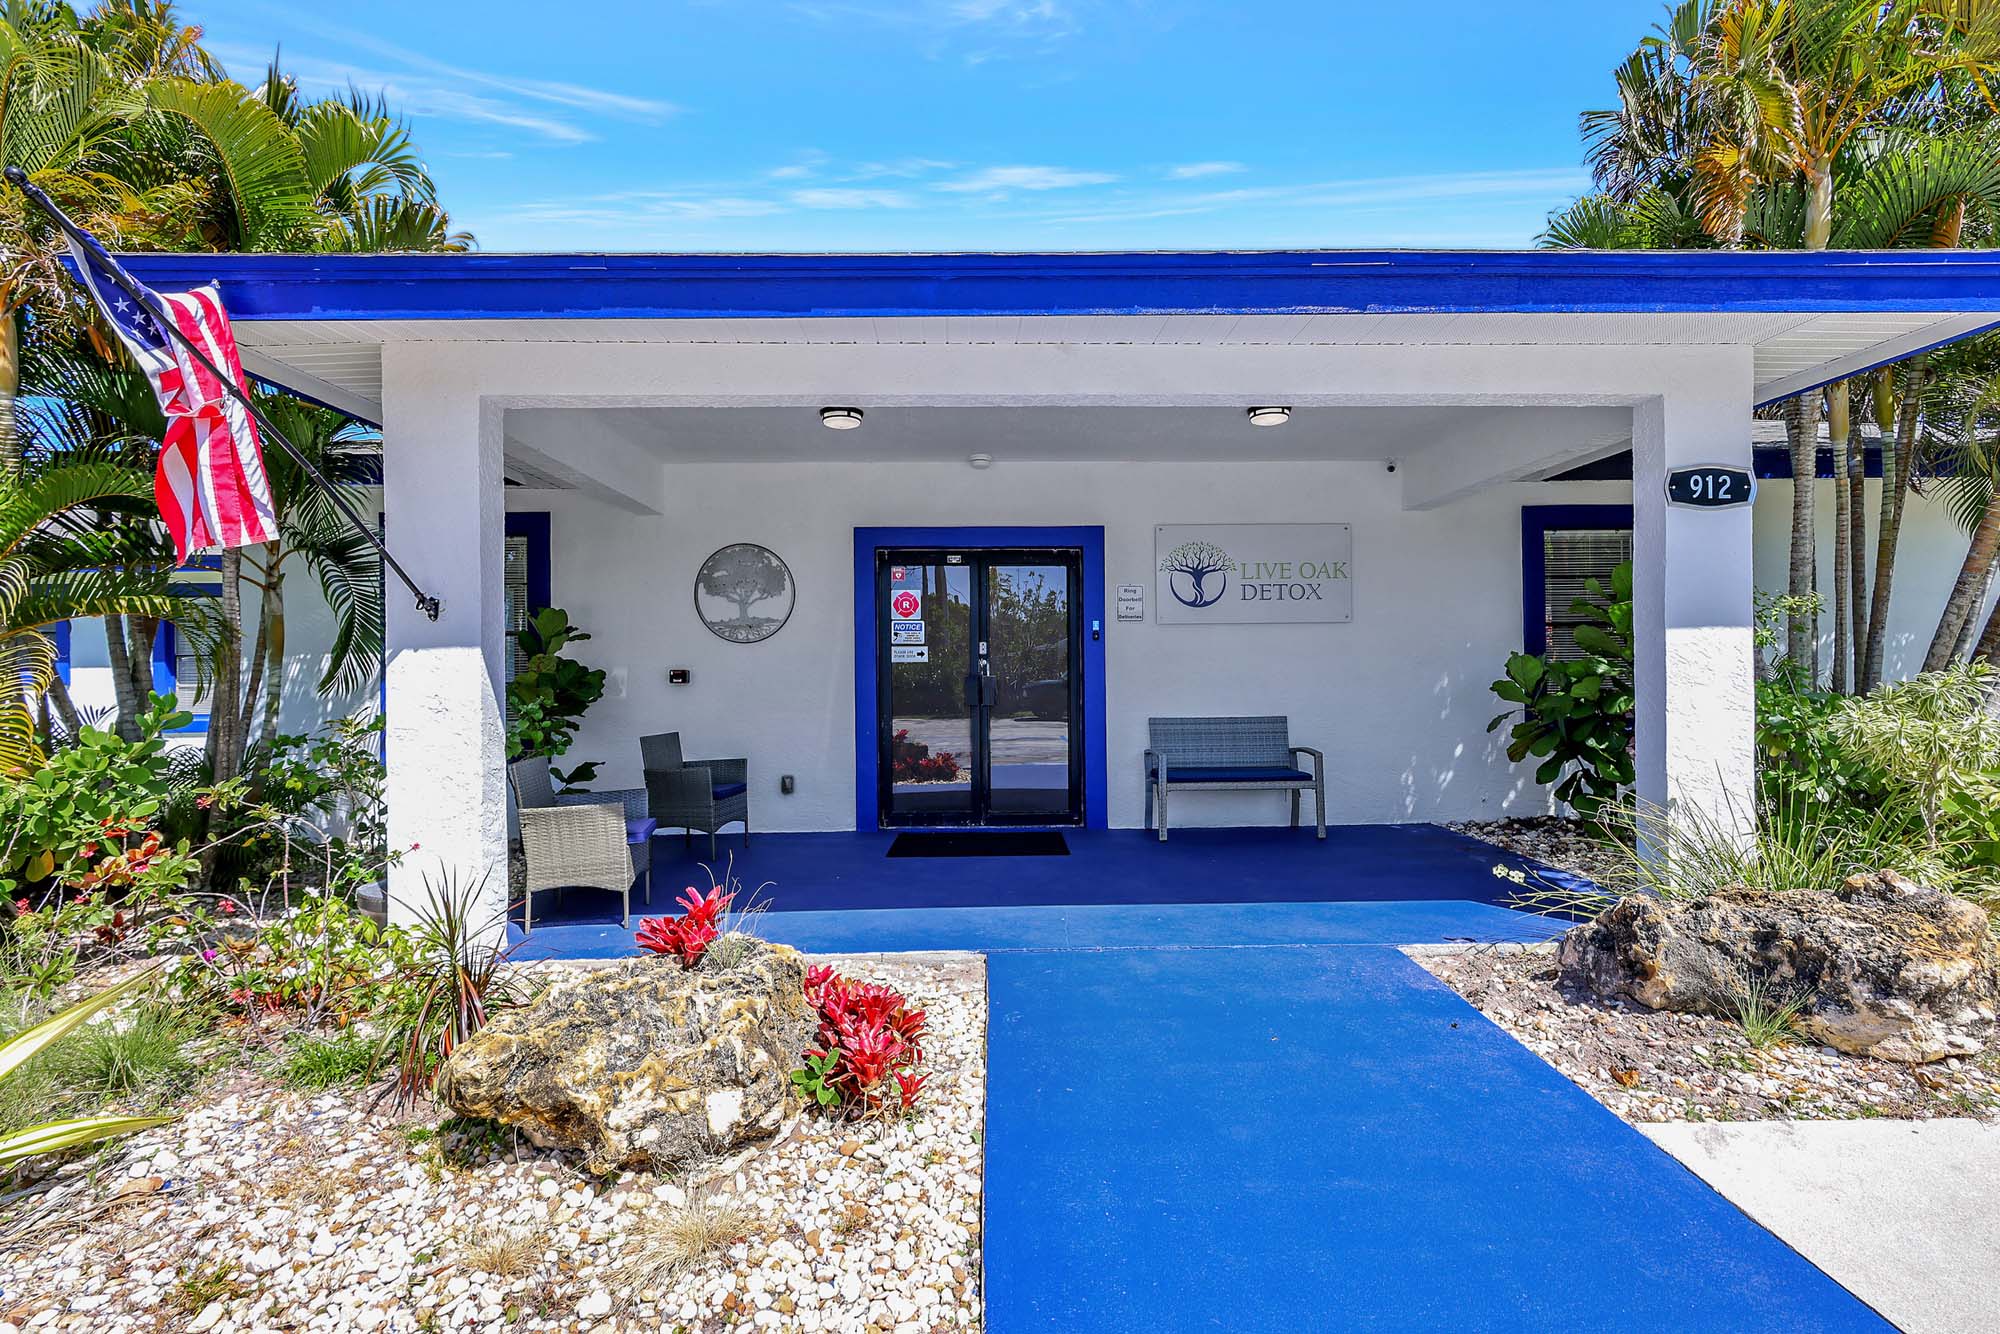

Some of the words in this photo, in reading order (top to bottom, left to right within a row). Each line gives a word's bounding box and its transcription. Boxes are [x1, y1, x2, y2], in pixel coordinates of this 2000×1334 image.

[1690, 474, 1732, 499] 912
[1240, 562, 1292, 580] LIVE
[1299, 561, 1349, 580] OAK
[1240, 583, 1323, 601] DETOX
[902, 601, 910, 609] R
[894, 623, 922, 631] NOTICE
